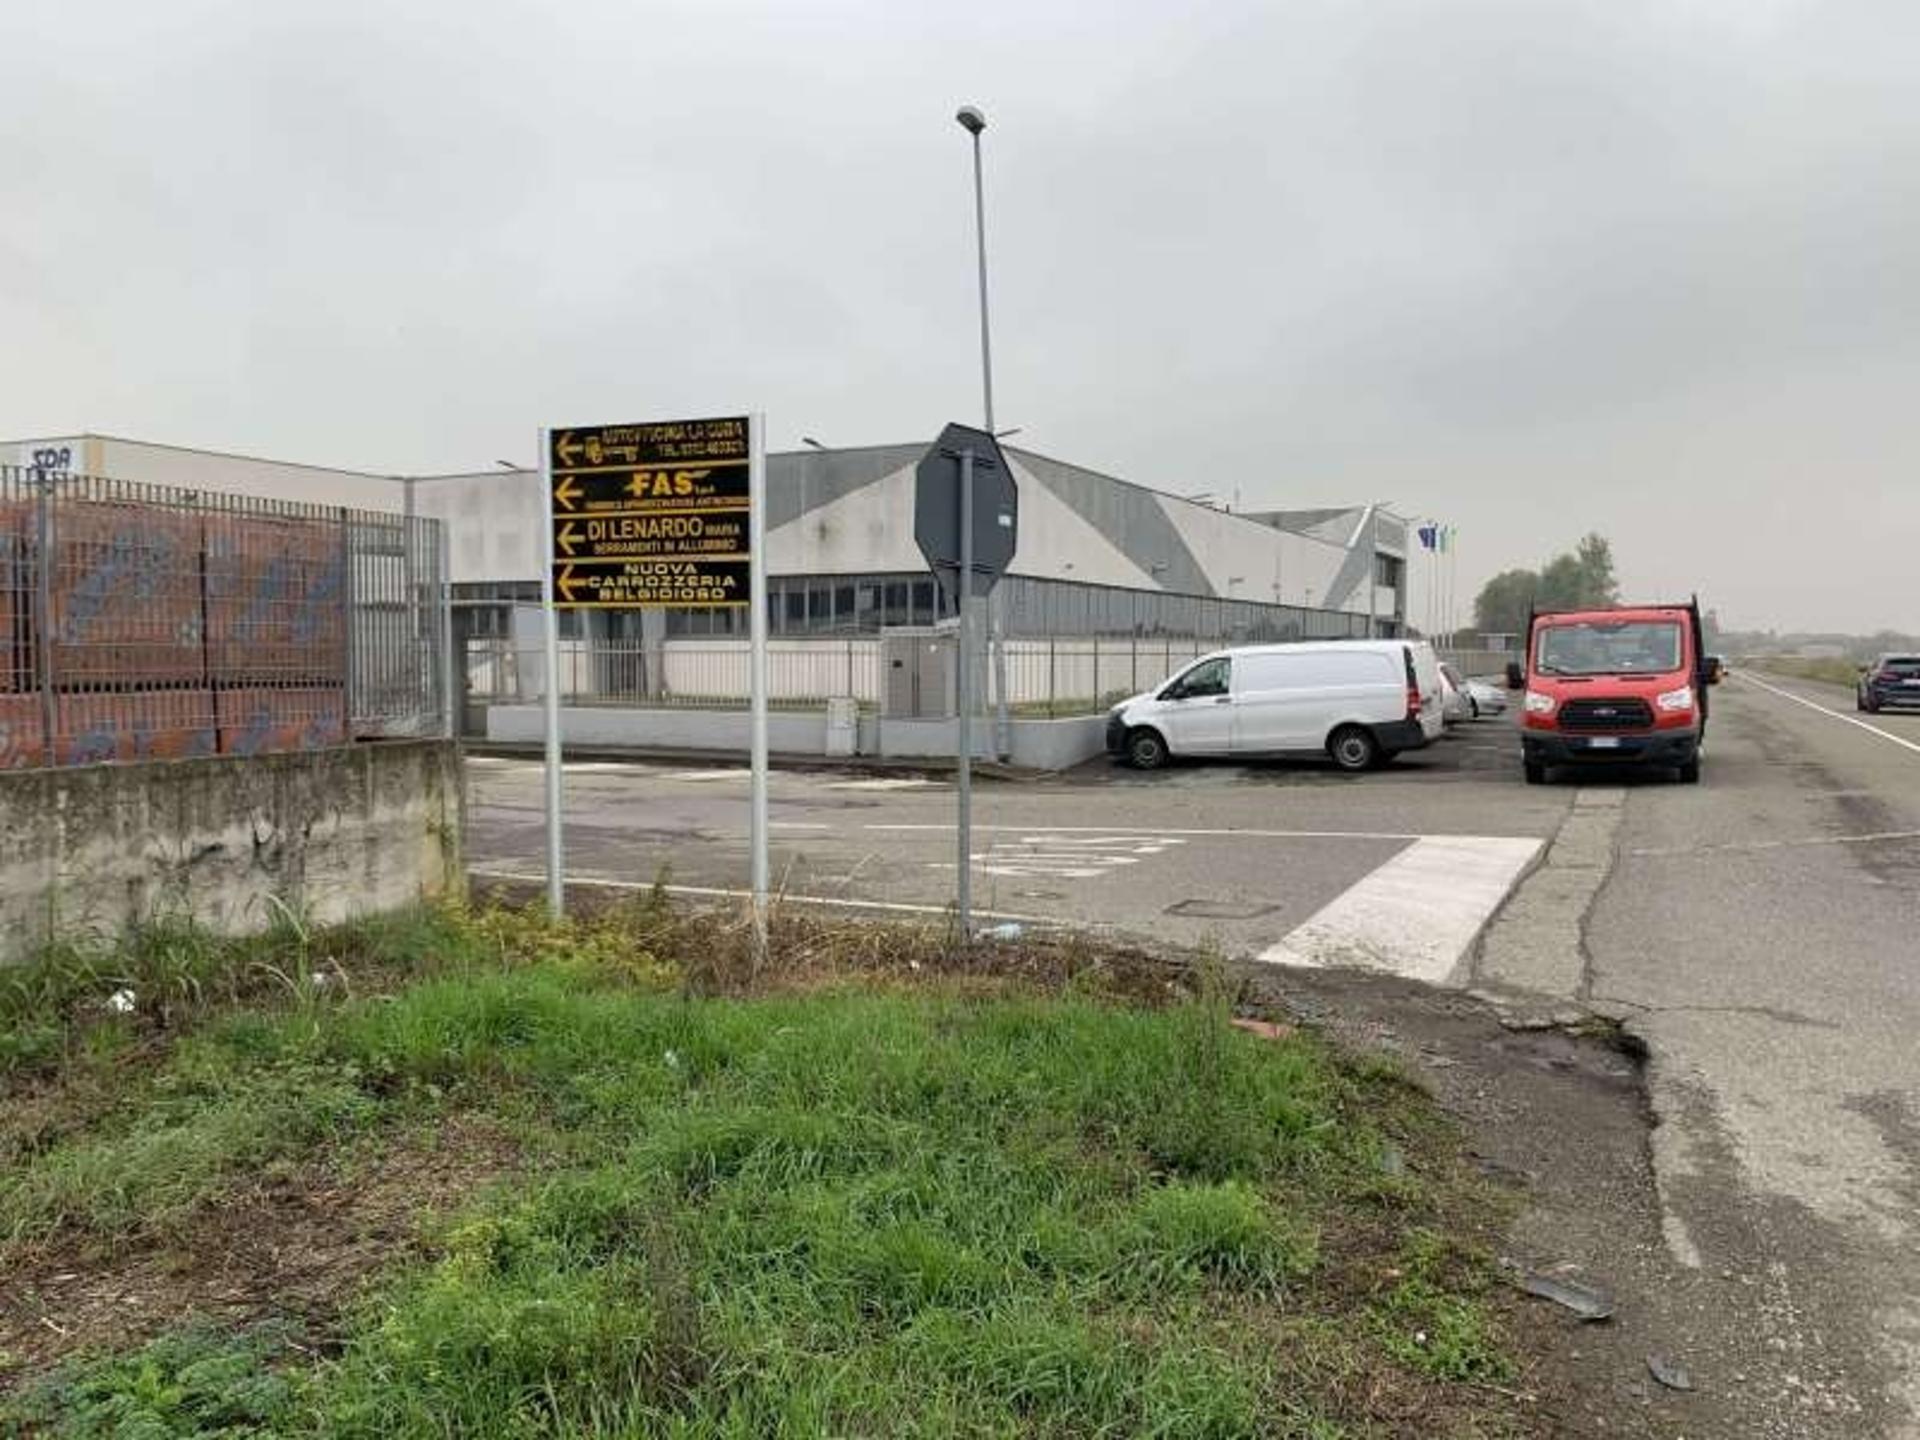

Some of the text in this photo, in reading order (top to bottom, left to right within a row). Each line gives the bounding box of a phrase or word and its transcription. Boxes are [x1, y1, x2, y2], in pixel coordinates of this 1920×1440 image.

[631, 471, 694, 496] FAS
[587, 520, 606, 541] DI
[609, 517, 704, 539] LENARDO
[625, 563, 697, 575] NUOVA
[589, 575, 736, 588] CARROZZERIA
[599, 588, 726, 601] BELGIOIOSO
